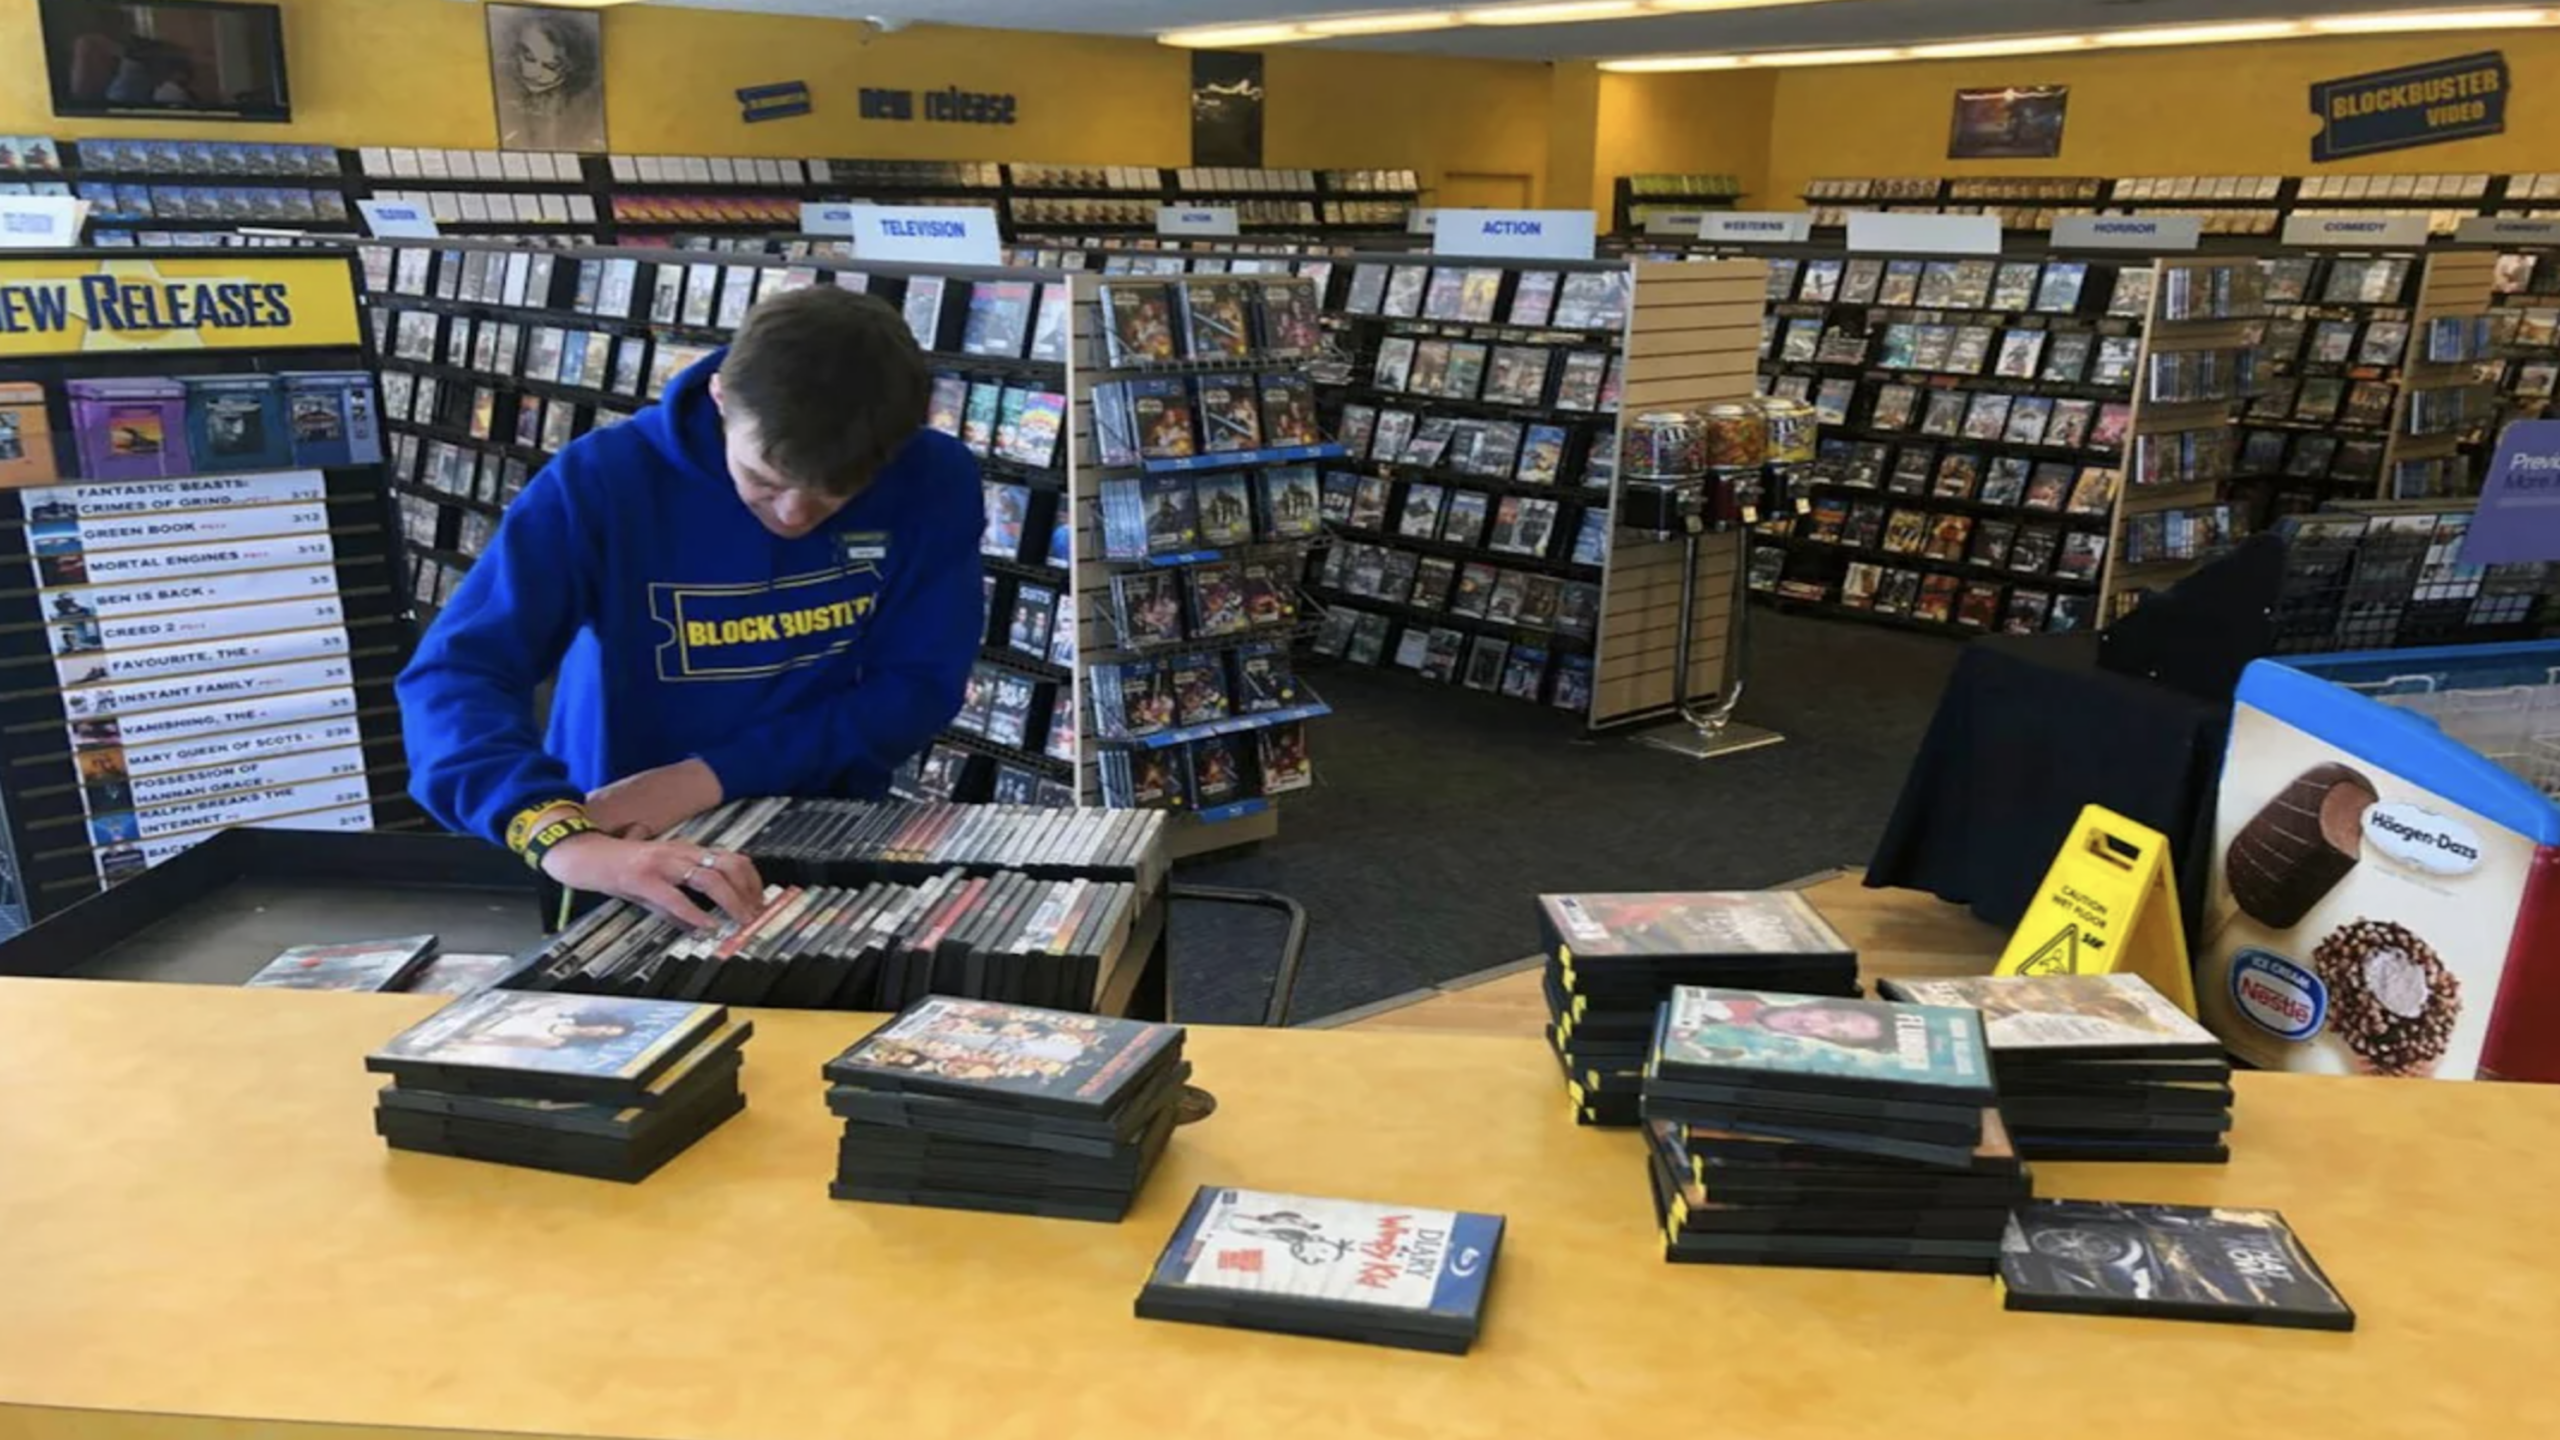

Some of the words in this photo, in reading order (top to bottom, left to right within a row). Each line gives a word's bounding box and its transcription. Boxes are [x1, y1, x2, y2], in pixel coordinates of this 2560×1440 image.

[858, 87, 913, 120] new
[924, 84, 1017, 124] release
[2331, 68, 2500, 121] BLOCKBUSTER
[2426, 101, 2485, 127] VIDEO
[880, 219, 967, 239] TELEVISION
[1481, 219, 1542, 237] ACTION
[2092, 221, 2157, 234] HORROR
[2323, 221, 2388, 233] COMEDY
[0, 284, 67, 333] EW
[80, 275, 291, 332] RELEASES
[77, 482, 174, 498] FANTASTIC
[179, 479, 249, 493] BEASTS:
[80, 501, 147, 514] CRIMES
[151, 499, 173, 510] OF
[84, 527, 143, 540] GREEN
[148, 522, 196, 535] BOOK
[89, 558, 160, 571] MORTAL
[165, 551, 239, 566] ENGINES
[95, 594, 132, 605] BEN
[136, 591, 153, 602] IS
[157, 587, 204, 599] BACK
[104, 624, 161, 639] CREED
[166, 622, 175, 633] 2
[112, 651, 213, 671] FAVOURITE,
[217, 647, 249, 659] THE
[119, 687, 190, 703] INSTANT
[195, 679, 254, 694] FAMILY
[224, 710, 256, 722] THE
[129, 752, 171, 765] MARY
[177, 745, 229, 759] QUEEN
[232, 740, 251, 751] OF
[256, 733, 303, 748] SCOTS
[133, 766, 235, 789] POSSESSION
[238, 763, 260, 774] OF
[209, 778, 262, 792] GRACE
[140, 805, 194, 819] RALPH
[196, 793, 261, 811] BREAKS
[264, 788, 294, 799] THE
[141, 813, 222, 834] INTERNET
[2370, 810, 2479, 860] Häagen-Dazs
[2051, 893, 2074, 910] WET
[2074, 906, 2107, 929] FLOOR
[2061, 885, 2108, 915] CAUTION
[2252, 956, 2269, 970] ICE
[2269, 960, 2312, 989] CREAM
[1359, 1214, 1413, 1259] Wimpy
[1406, 1227, 1445, 1280] DIARY
[1356, 1262, 1399, 1290] Kid
